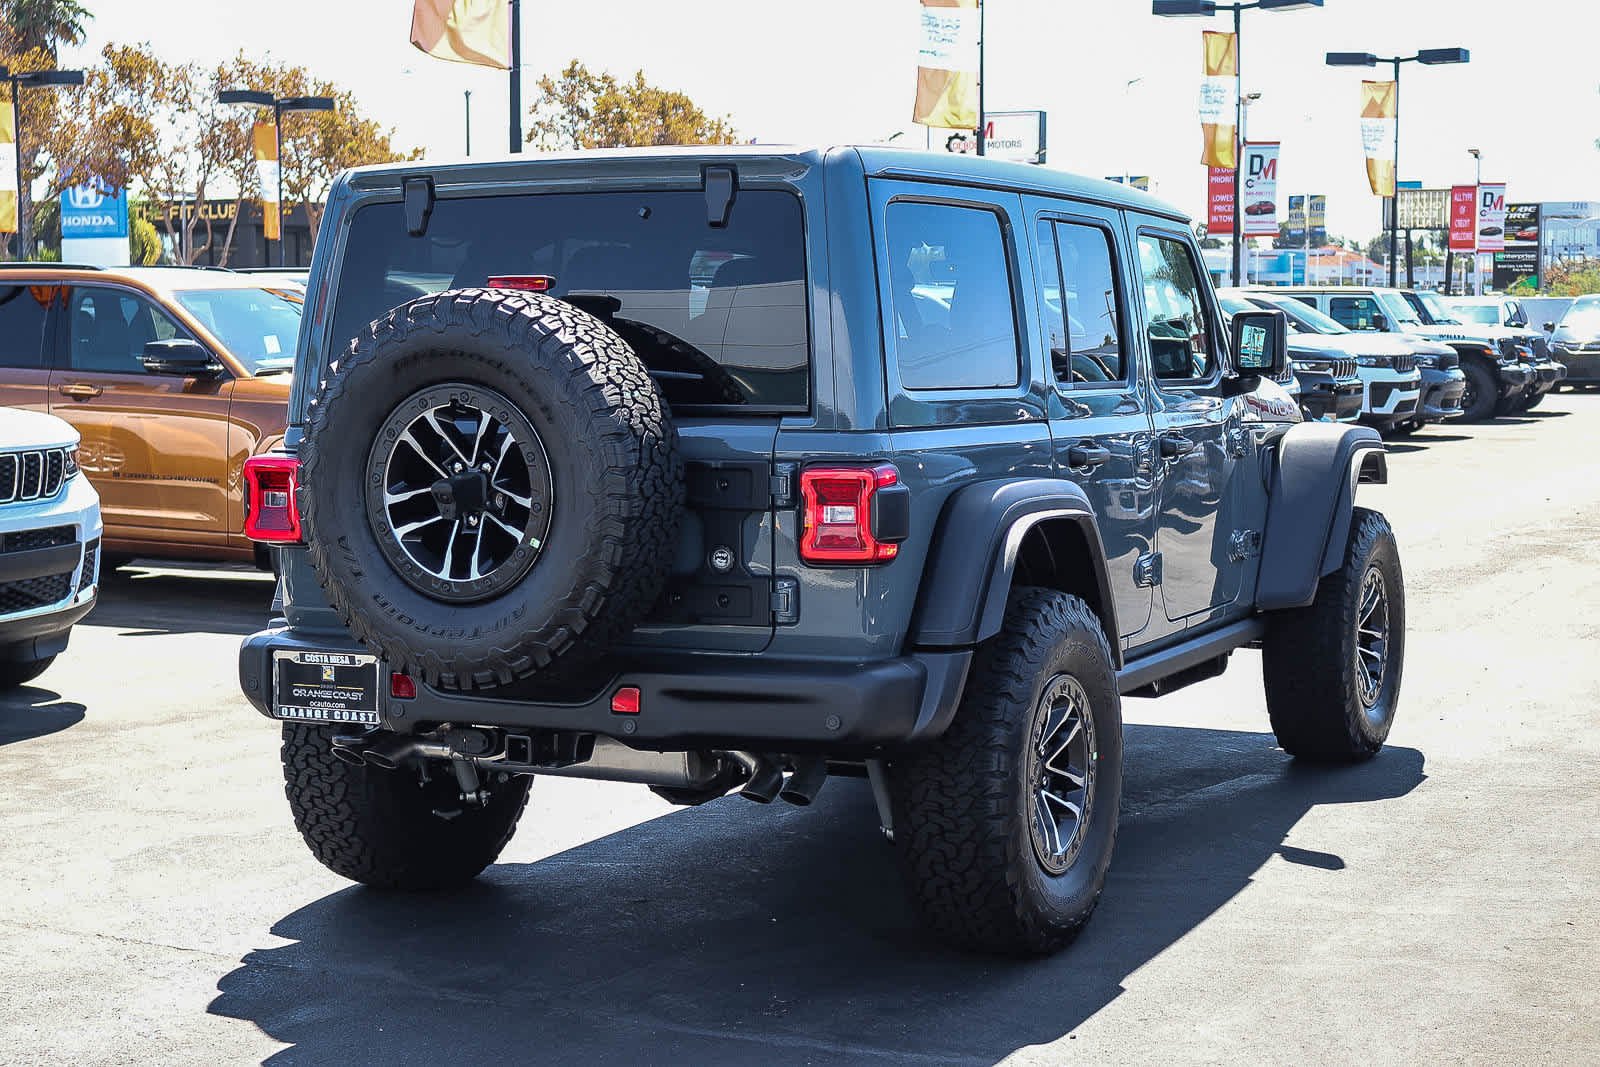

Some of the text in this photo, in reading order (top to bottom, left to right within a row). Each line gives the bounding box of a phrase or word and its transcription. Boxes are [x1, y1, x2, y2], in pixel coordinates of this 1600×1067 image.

[987, 140, 1022, 149] MOTORS
[1211, 175, 1234, 184] PRIORIT
[1212, 194, 1234, 202] LOWES
[63, 216, 116, 226] HONDA
[1219, 215, 1234, 223] TOW
[304, 653, 350, 665] COSTA MESA
[292, 688, 364, 701] ORANGE COAST
[309, 700, 346, 708] ocauto.com
[282, 707, 374, 721] ORANGE COAST
